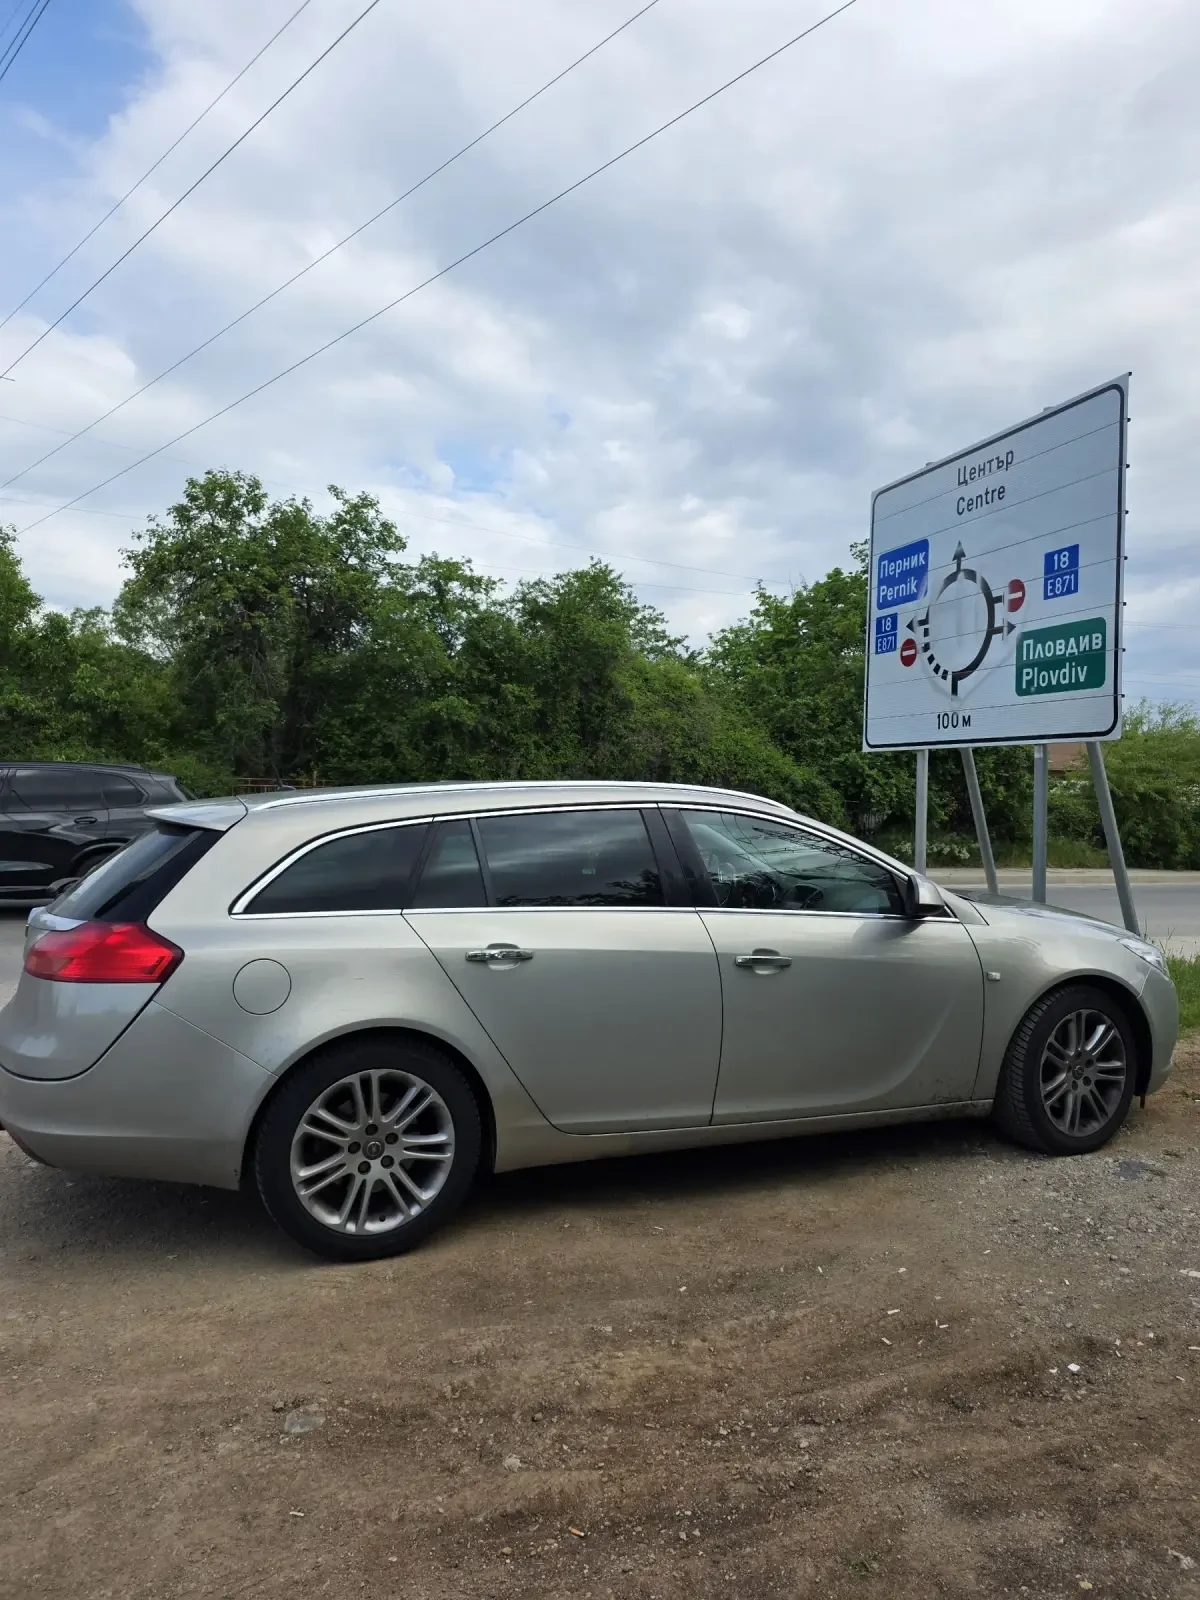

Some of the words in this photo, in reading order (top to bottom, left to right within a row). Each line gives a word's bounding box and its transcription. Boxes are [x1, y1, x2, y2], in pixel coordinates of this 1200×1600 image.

[957, 450, 1014, 486] Център
[956, 485, 1006, 515] Centre
[880, 551, 926, 578] Перник
[1053, 551, 1069, 570] 18
[879, 576, 918, 603] Pernik
[1047, 574, 1075, 596] E871
[881, 617, 892, 632] 18
[877, 635, 895, 652] E871
[1022, 632, 1103, 661] Пловдив
[1022, 662, 1088, 689] Plovdiv
[937, 711, 959, 730] 100
